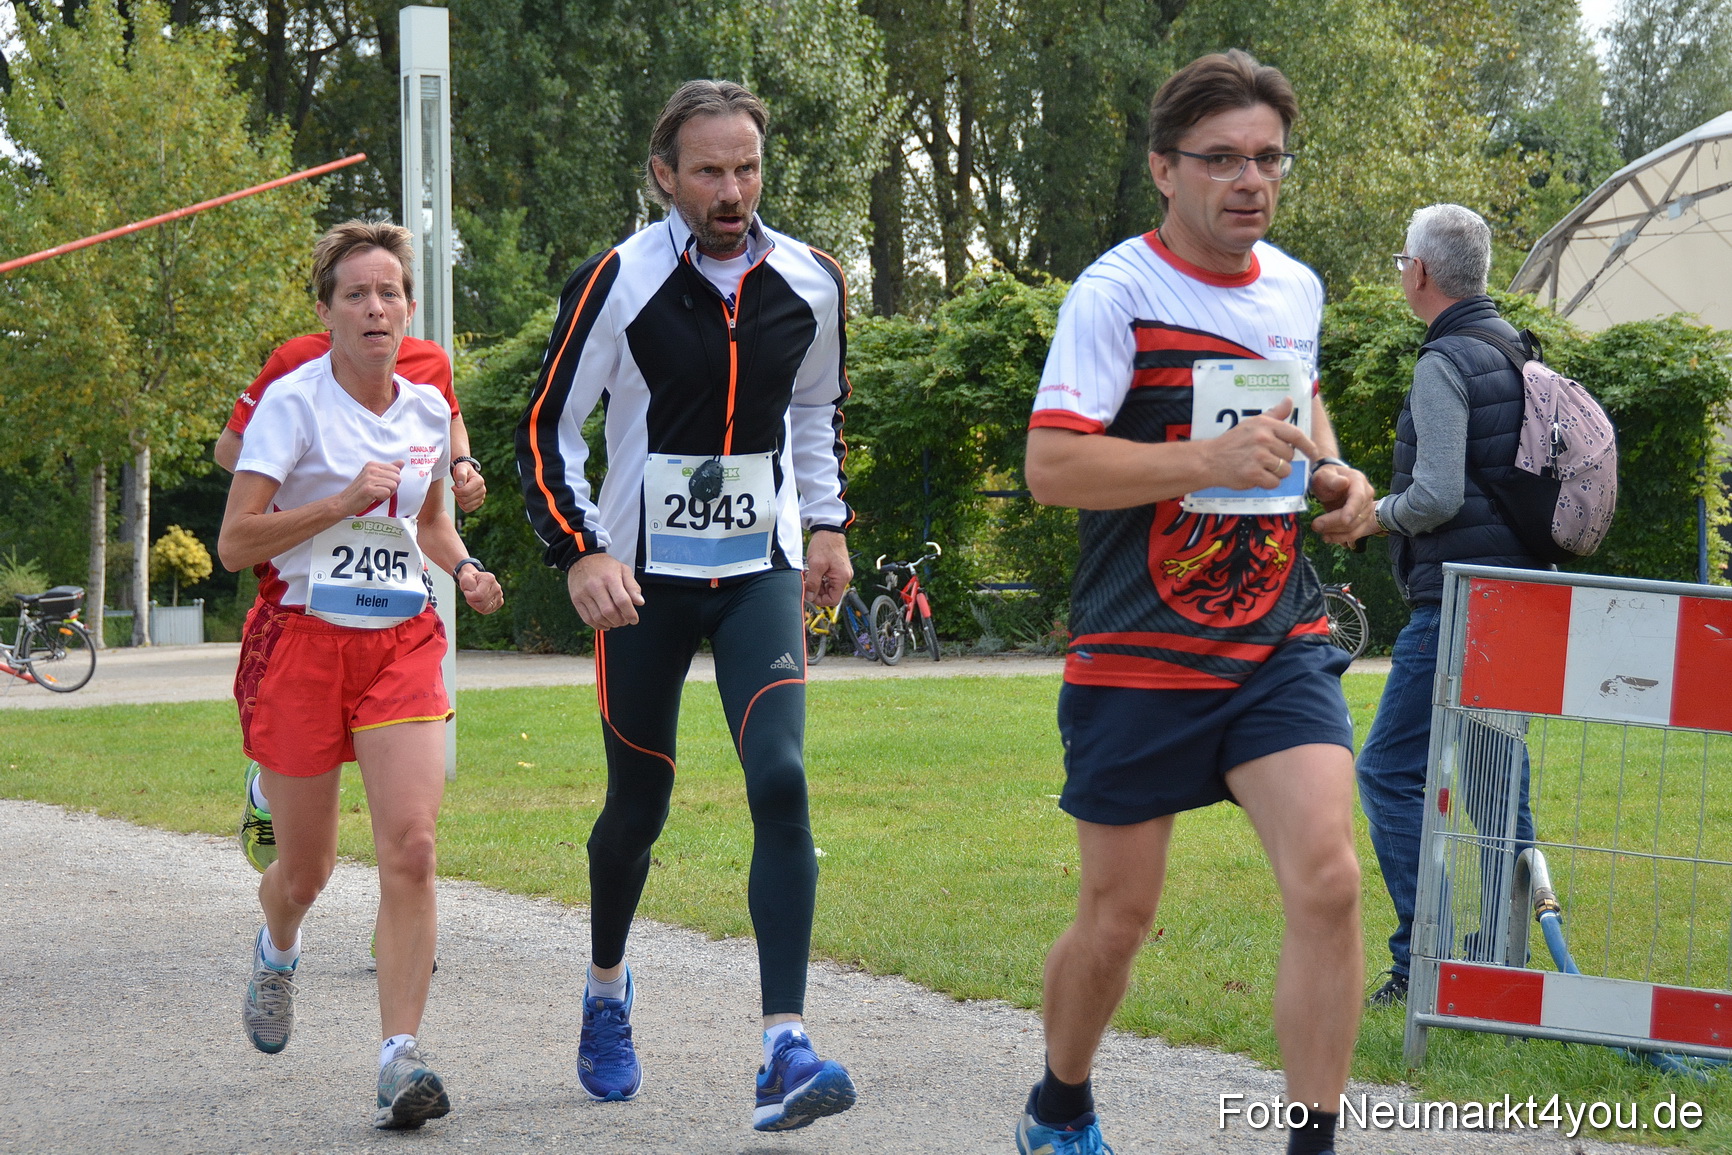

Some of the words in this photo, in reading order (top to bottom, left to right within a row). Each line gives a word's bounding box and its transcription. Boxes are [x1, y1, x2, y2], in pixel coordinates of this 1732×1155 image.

[1267, 335, 1314, 354] NEUMARKT
[1246, 374, 1290, 388] BOCK
[1216, 408, 1300, 431] 274
[409, 445, 428, 453] CANADA
[410, 457, 424, 466] ROAD
[664, 493, 757, 531] 2943
[365, 521, 405, 536] BOCK
[330, 545, 409, 584] 2495
[356, 593, 389, 608] Helen
[770, 662, 799, 672] adidas
